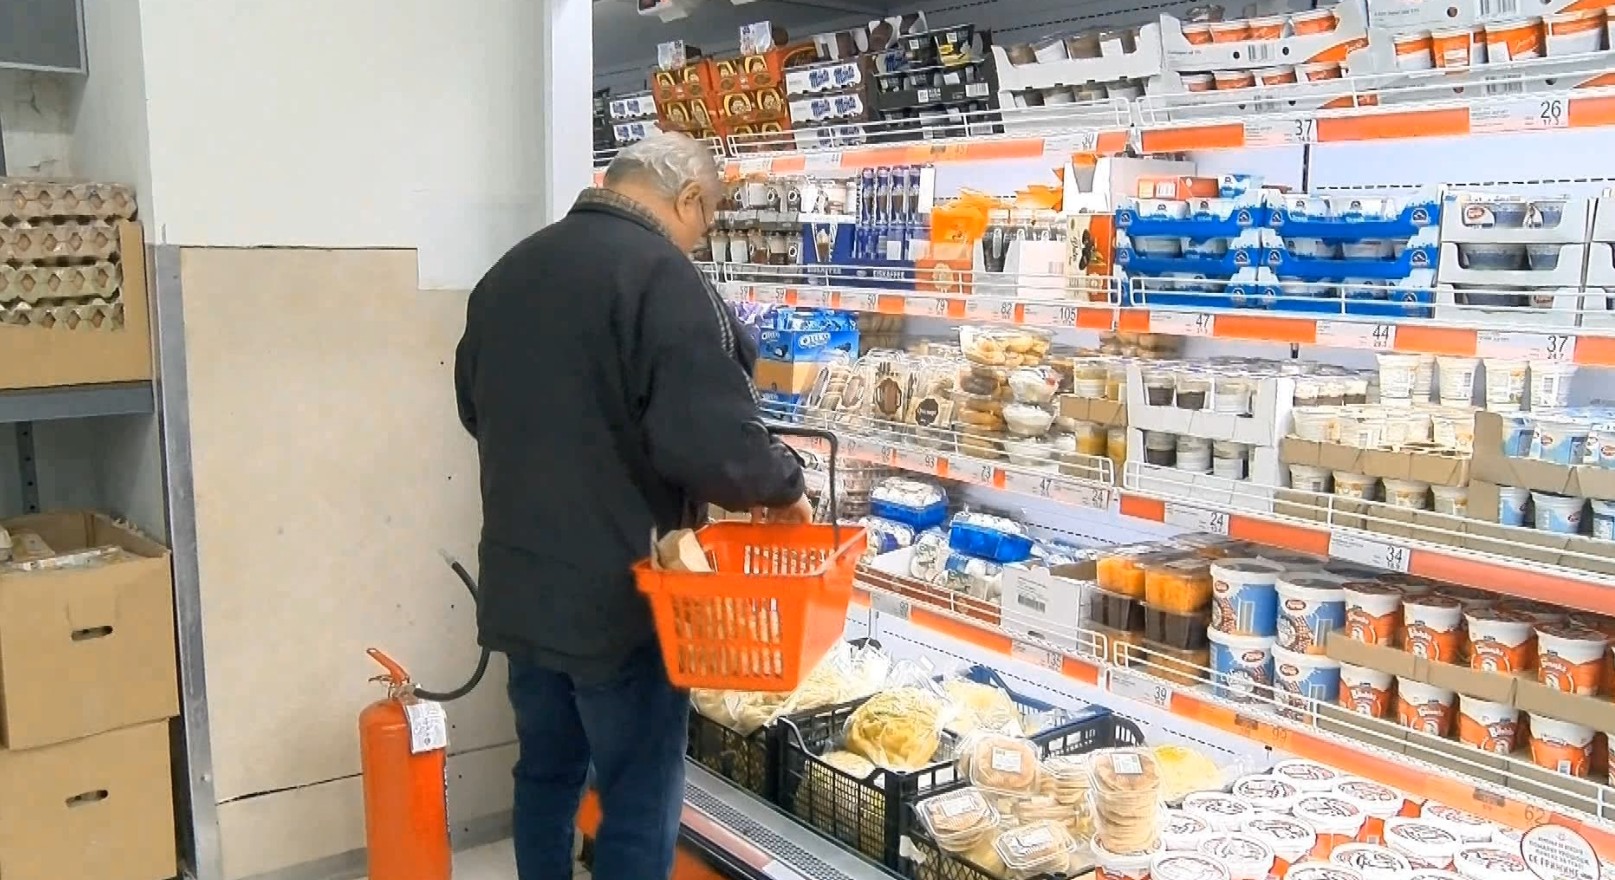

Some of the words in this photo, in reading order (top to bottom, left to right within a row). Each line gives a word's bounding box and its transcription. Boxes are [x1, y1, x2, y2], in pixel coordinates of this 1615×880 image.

[1540, 100, 1561, 119] 26
[1295, 119, 1313, 136] 37
[1060, 307, 1076, 321] 105
[1195, 312, 1210, 328] 47
[1372, 325, 1389, 340] 44
[1546, 335, 1568, 352] 37
[1210, 512, 1223, 526] 24
[1386, 545, 1403, 563] 34
[1154, 686, 1167, 700] 39
[1524, 805, 1546, 824] 62
